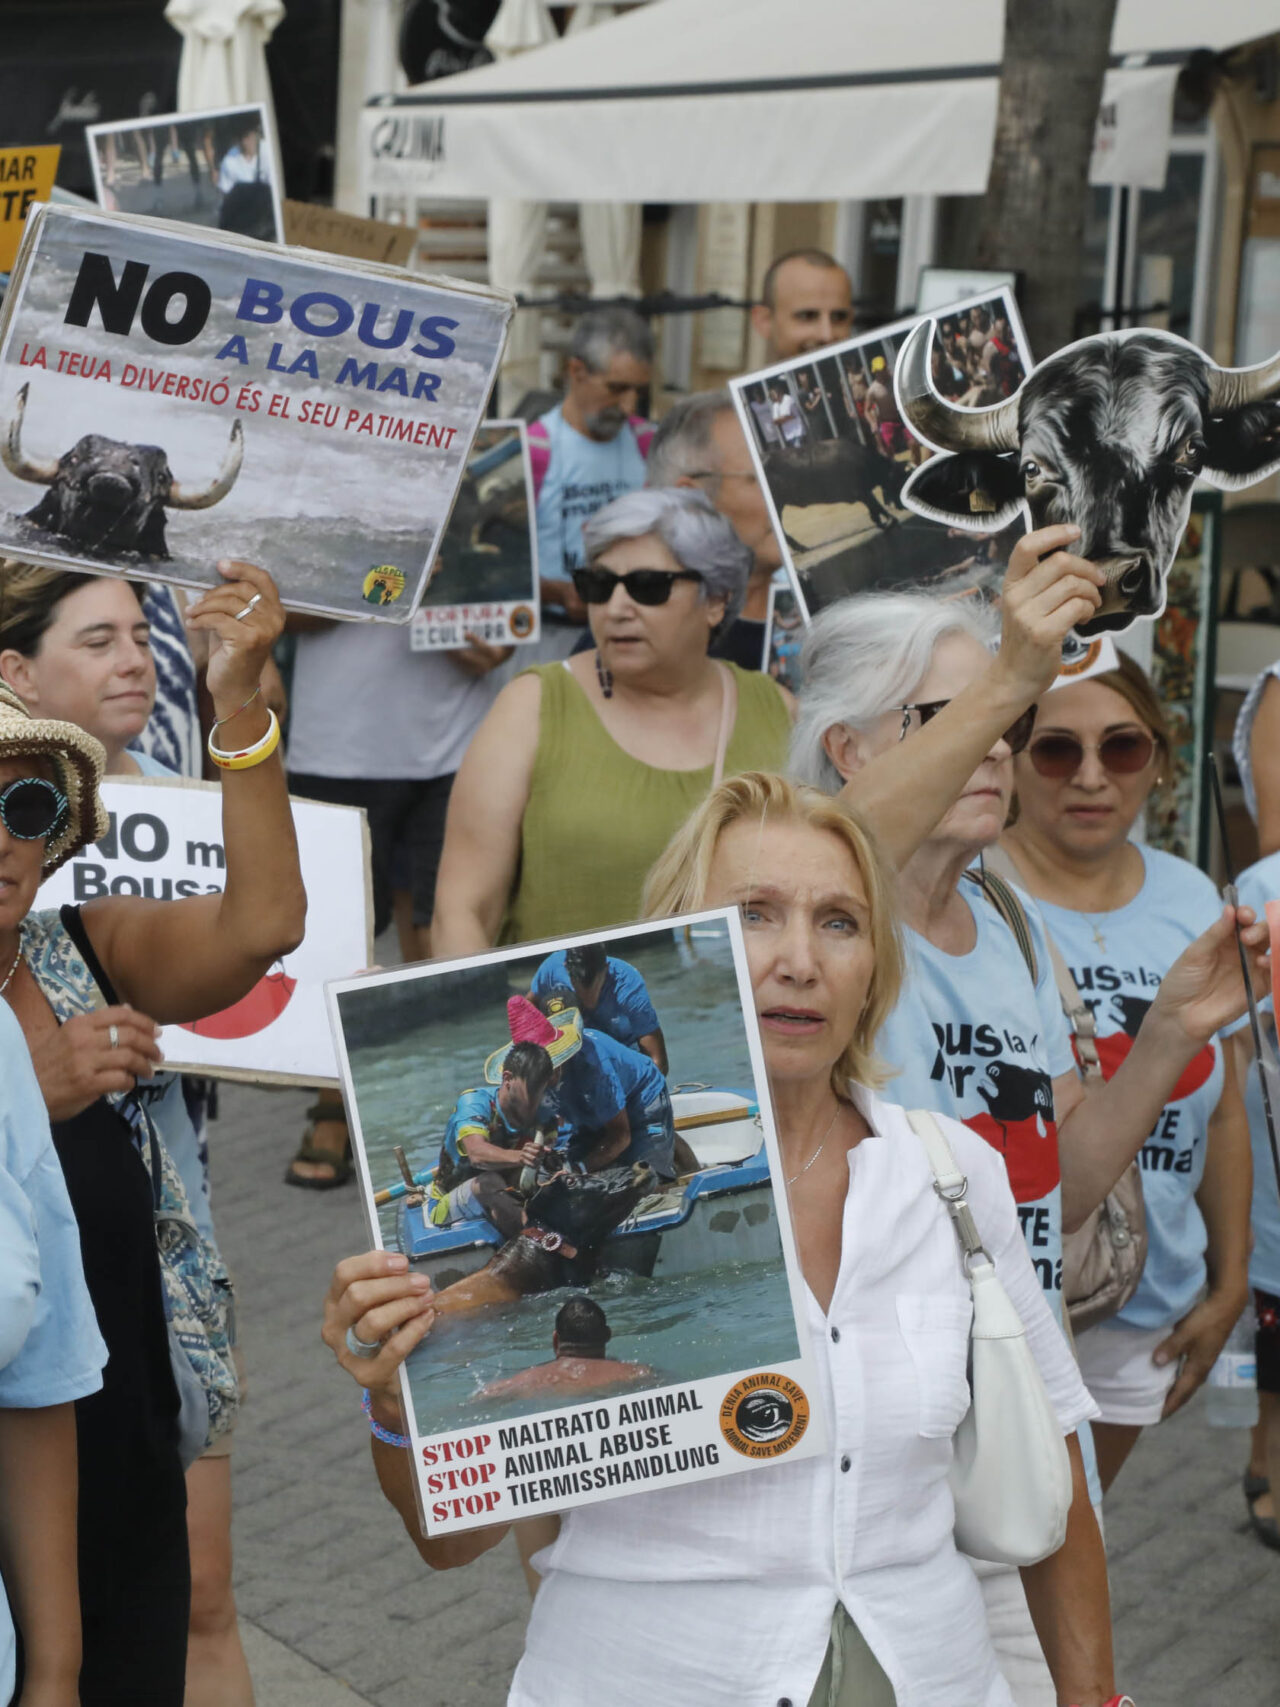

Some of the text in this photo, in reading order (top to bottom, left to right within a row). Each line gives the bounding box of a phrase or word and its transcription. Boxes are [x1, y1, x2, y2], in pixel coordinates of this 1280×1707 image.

[63, 252, 461, 360] NO BOUS
[19, 343, 48, 369] LA
[57, 350, 112, 383] TEUA
[120, 363, 230, 405] DIVERSIÓ
[235, 381, 263, 412] ÉS
[267, 394, 291, 419] EL
[297, 400, 341, 428] SEU
[344, 409, 458, 450] PATIMENT
[215, 335, 442, 403] A LA MAR
[422, 1389, 703, 1466] STOP MALTRATO ANIMAL
[722, 1375, 804, 1417] DENIA ANIMAL SAVE
[427, 1423, 673, 1494] STOP ANIMAL ABUSE
[724, 1414, 807, 1456] ANIMAL SAVE MOVEMENT
[432, 1443, 720, 1522] STOP TIERMISSHANDLUNG
